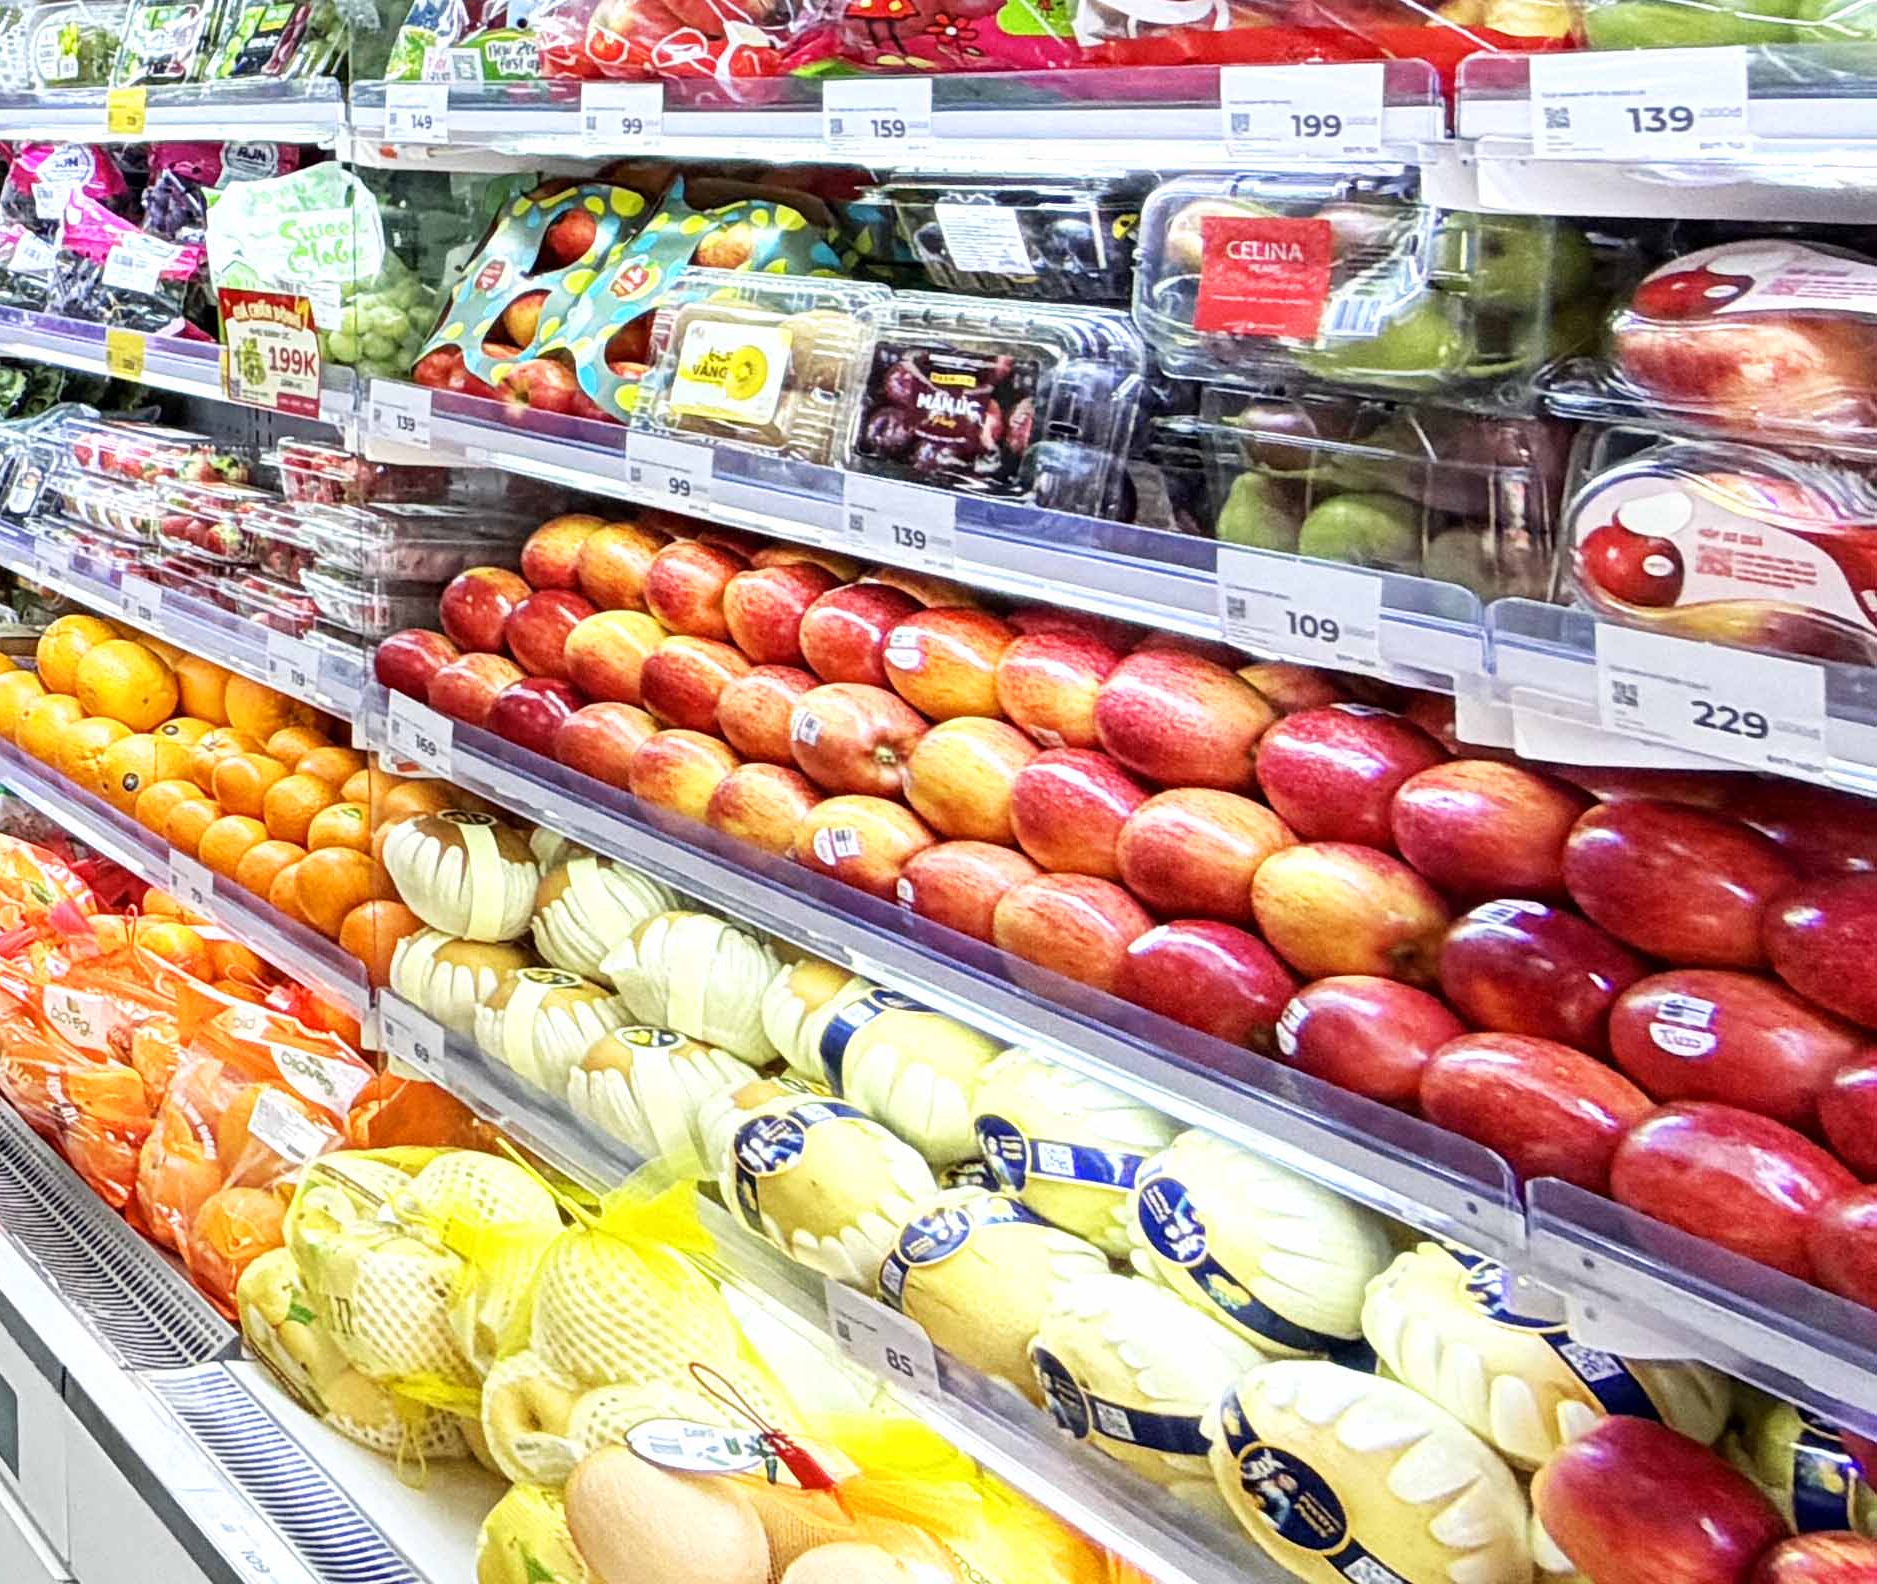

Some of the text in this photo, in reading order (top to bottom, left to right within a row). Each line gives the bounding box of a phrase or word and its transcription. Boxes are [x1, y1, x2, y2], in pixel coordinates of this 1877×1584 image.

[410, 114, 433, 130] 149
[622, 118, 644, 135] 99
[870, 119, 907, 139] 159
[1289, 114, 1343, 138] 199
[1625, 105, 1696, 134] 139
[1226, 240, 1305, 262] CELINA
[267, 345, 318, 378] 199K
[396, 415, 416, 432] 139
[667, 477, 692, 497] 99
[892, 526, 928, 550] 139
[1285, 610, 1341, 643] 109
[1690, 700, 1770, 740] 229
[414, 733, 437, 757] 169
